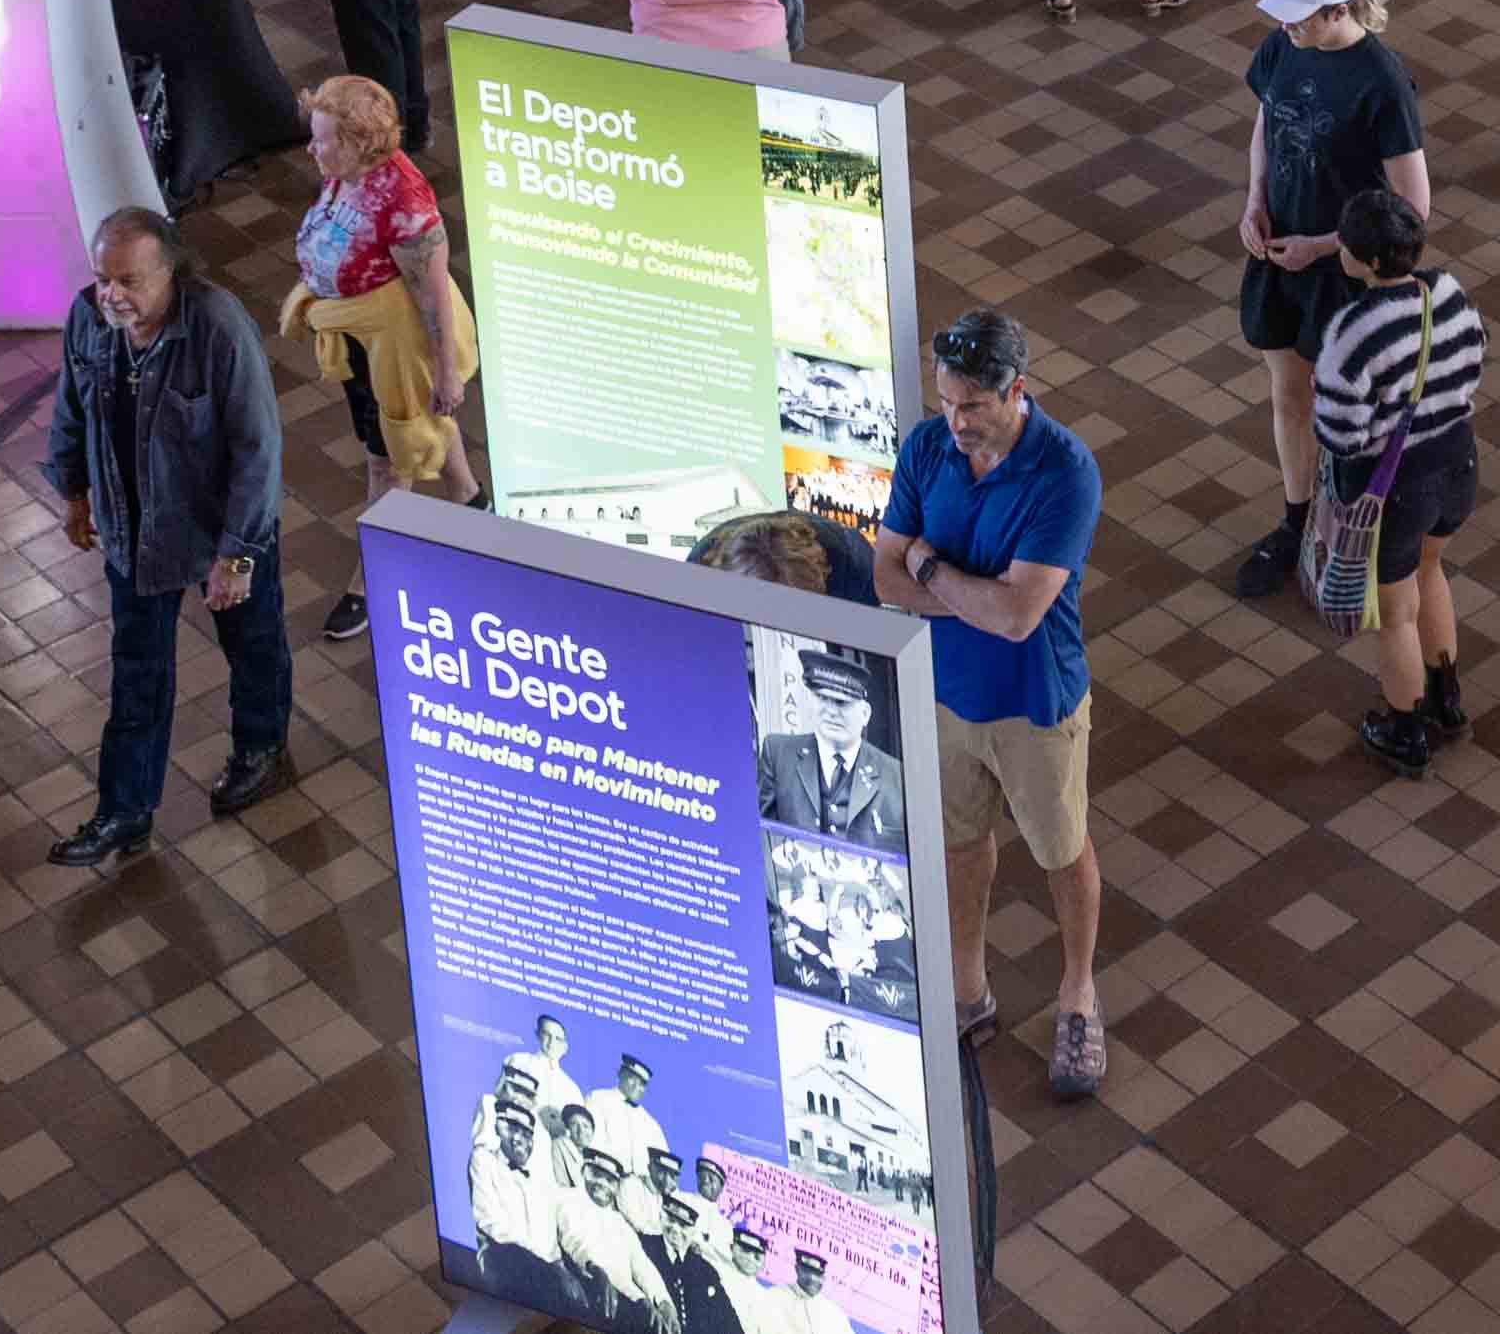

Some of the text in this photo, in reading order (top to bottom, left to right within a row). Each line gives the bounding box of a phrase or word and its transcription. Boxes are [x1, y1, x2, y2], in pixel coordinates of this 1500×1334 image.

[478, 80, 637, 141] El Depot
[479, 119, 684, 188] transformó
[485, 160, 616, 210] a Boise
[398, 590, 607, 679] La Gente
[404, 639, 627, 730] del Depot
[408, 692, 720, 795] Trabajando para Mantener
[411, 722, 716, 822] las Ruedas en Movimiento
[762, 1211, 790, 1237] LAKE
[796, 1227, 822, 1249] CITY
[828, 1241, 840, 1256] to
